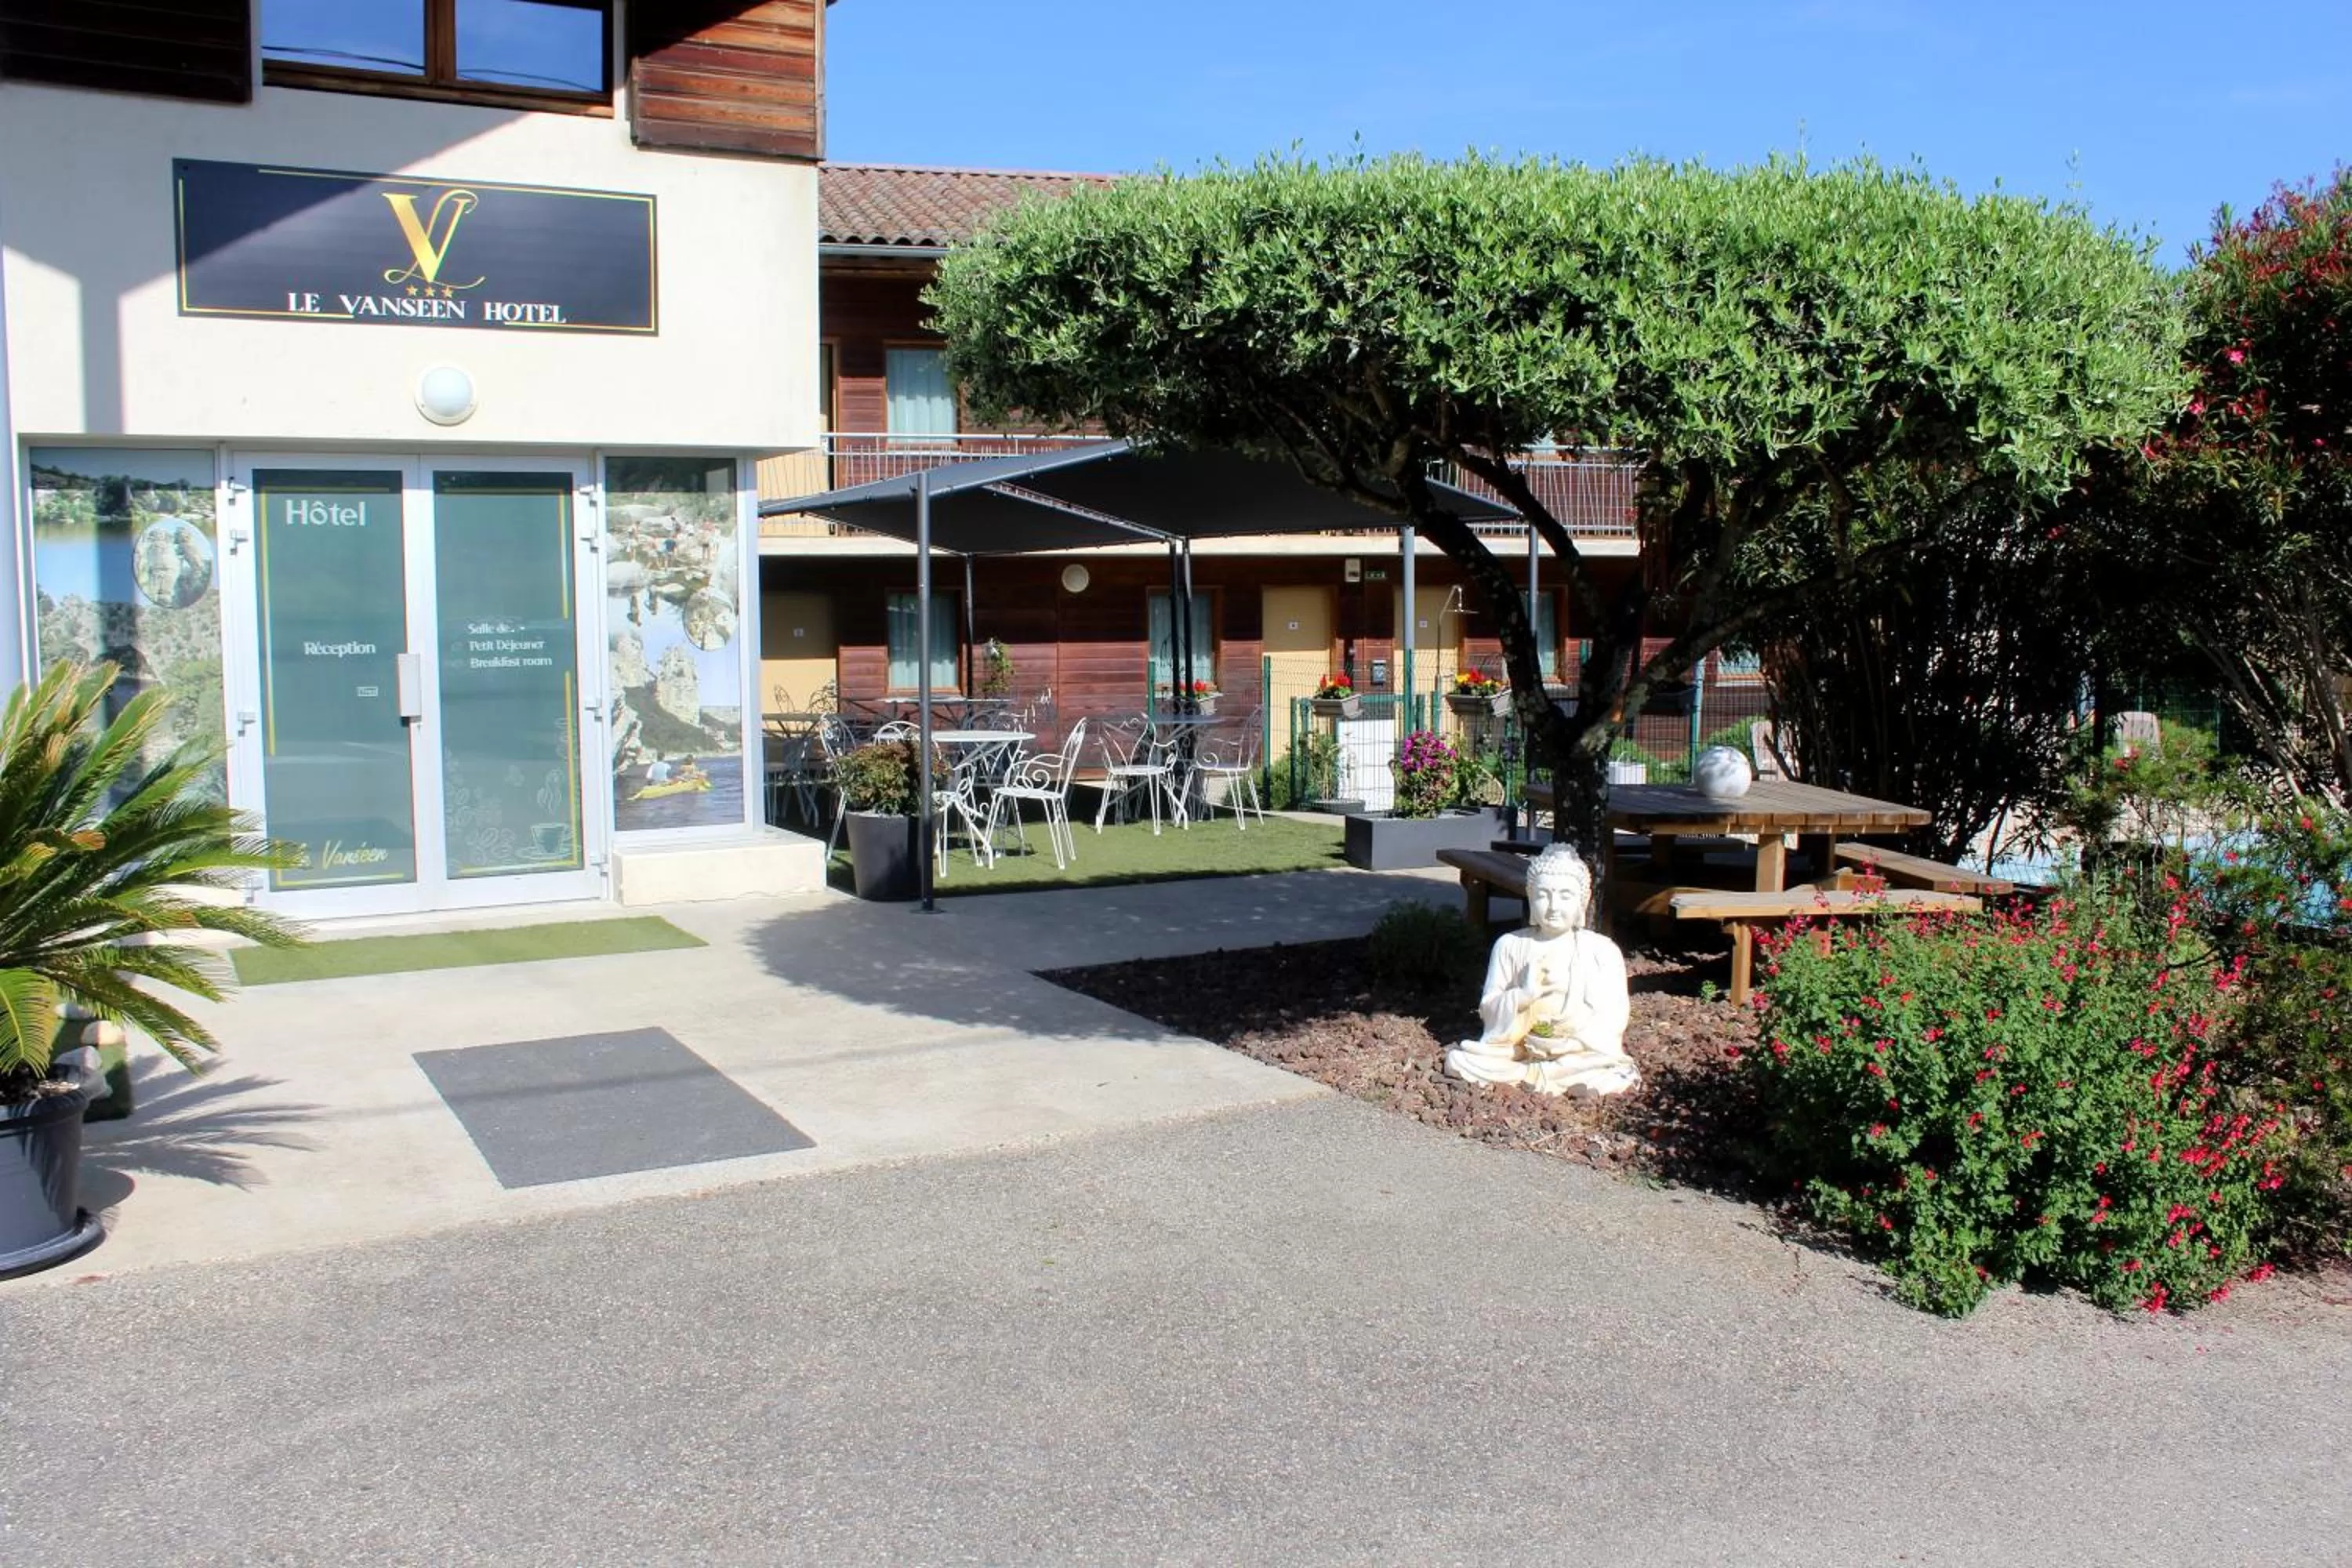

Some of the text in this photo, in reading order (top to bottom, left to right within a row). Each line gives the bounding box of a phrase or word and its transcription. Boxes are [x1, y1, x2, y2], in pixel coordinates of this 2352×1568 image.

[289, 292, 567, 323] LE VANSEEN HOTEL
[285, 499, 366, 526] Hôtel
